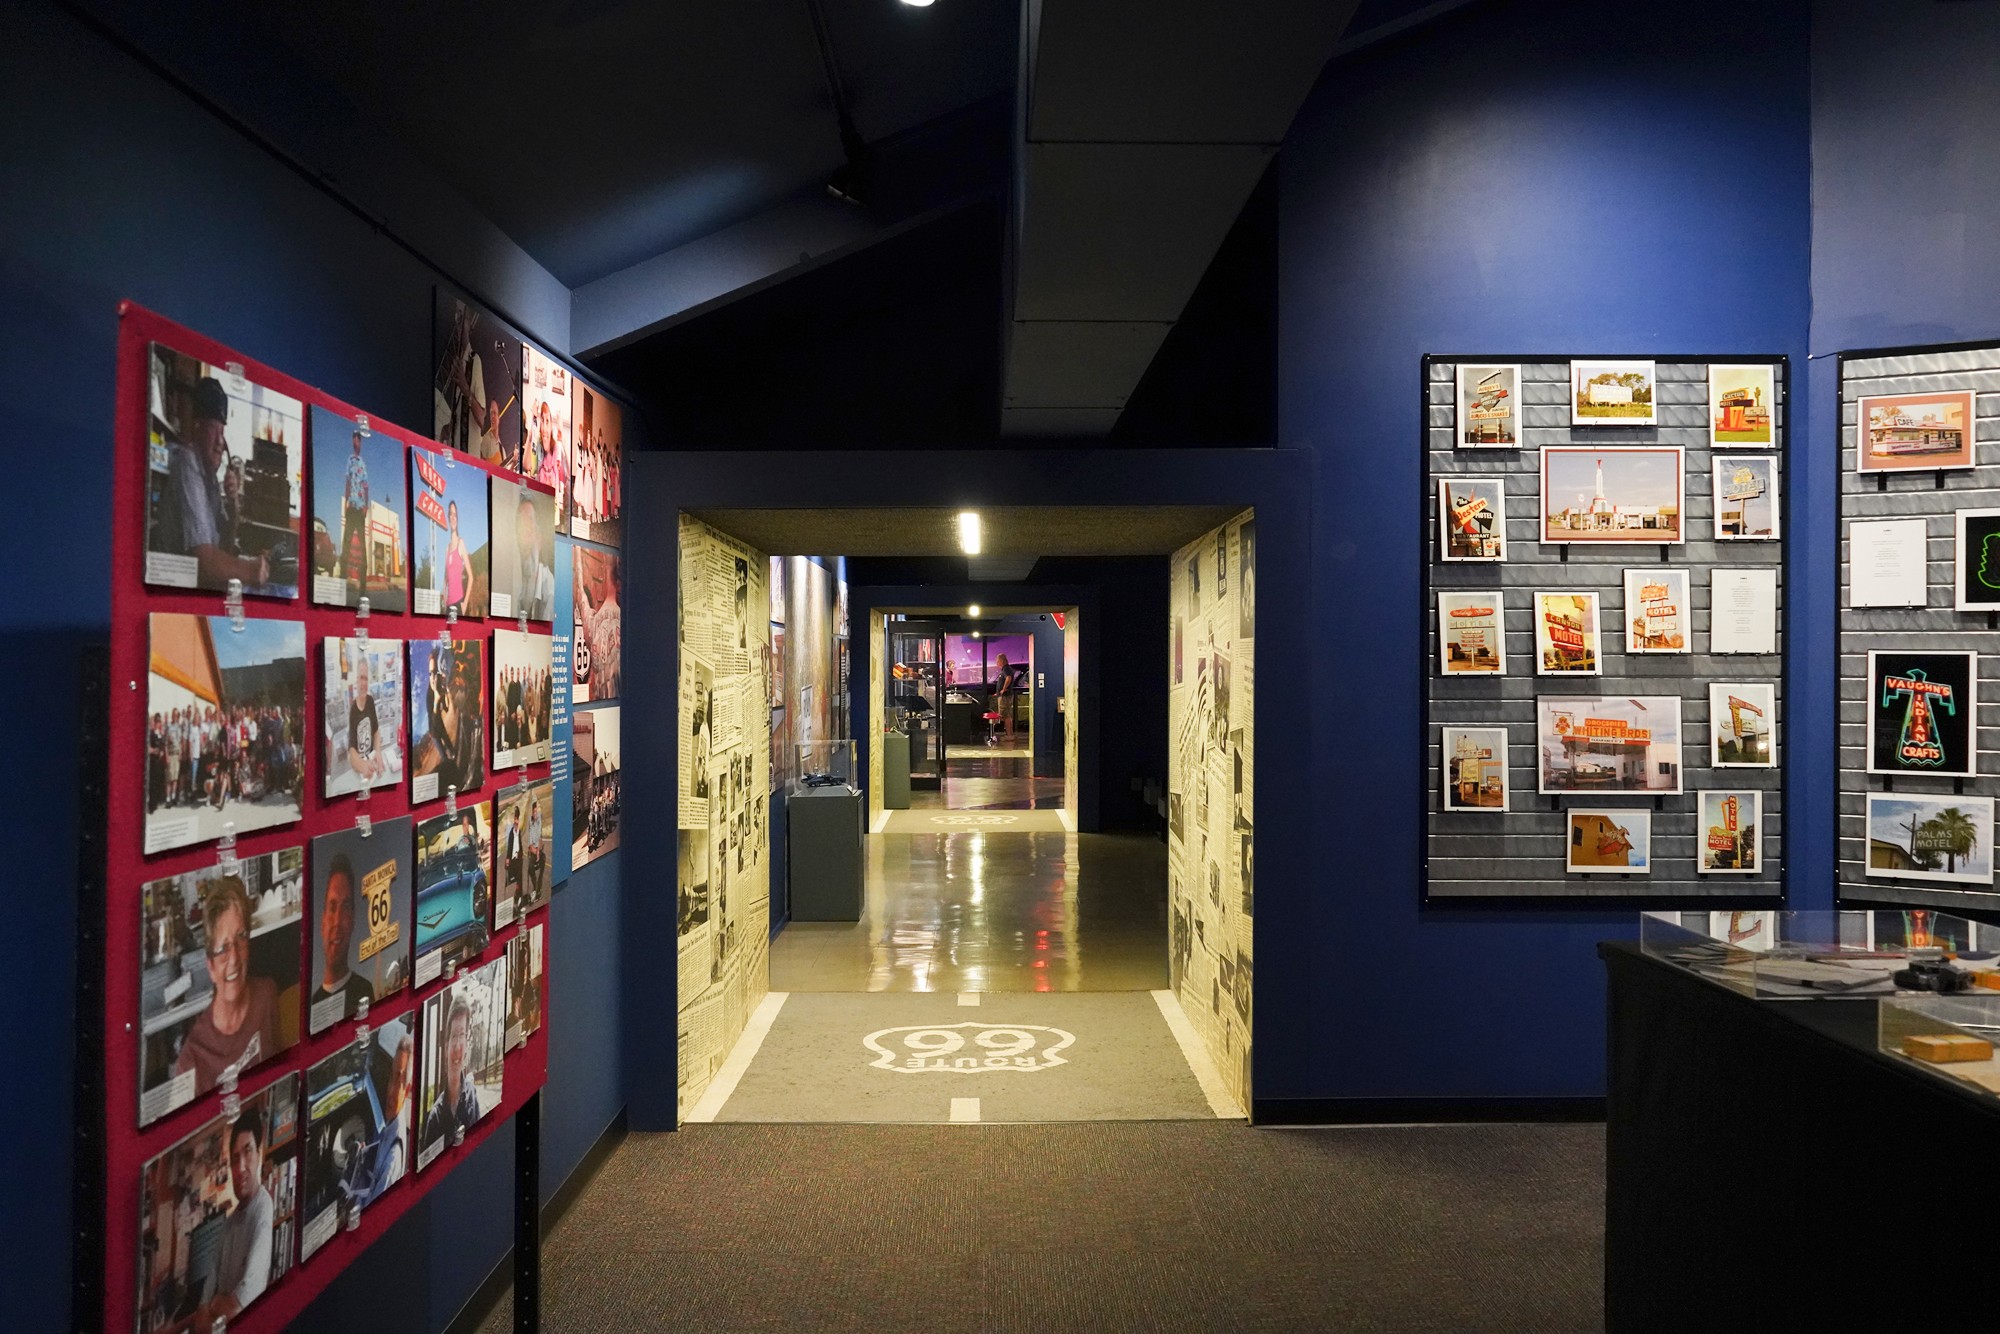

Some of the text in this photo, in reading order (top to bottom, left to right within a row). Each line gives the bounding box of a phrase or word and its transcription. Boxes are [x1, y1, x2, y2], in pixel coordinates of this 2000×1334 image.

[1897, 418, 1914, 426] CAFE
[421, 496, 443, 520] CAFE
[1454, 499, 1486, 522] Western
[1550, 614, 1581, 630] CANYON
[1554, 629, 1583, 646] MOTEL
[576, 641, 588, 671] 66
[1887, 678, 1951, 696] VAUGHN'S
[1586, 720, 1627, 728] GROCERIES
[1914, 694, 1925, 742] INDIAN
[1573, 726, 1648, 738] WHITING BROS
[1903, 746, 1940, 759] CRAFTS
[1916, 830, 1953, 839] PALMS
[1916, 839, 1953, 848] MOTEL
[362, 862, 395, 889] SANTA MONICA
[371, 889, 388, 927] 66
[361, 943, 371, 956] End
[372, 937, 377, 951] of
[378, 933, 386, 946] the
[903, 1029, 1037, 1058] 66
[906, 1056, 1036, 1068] ROUTE
